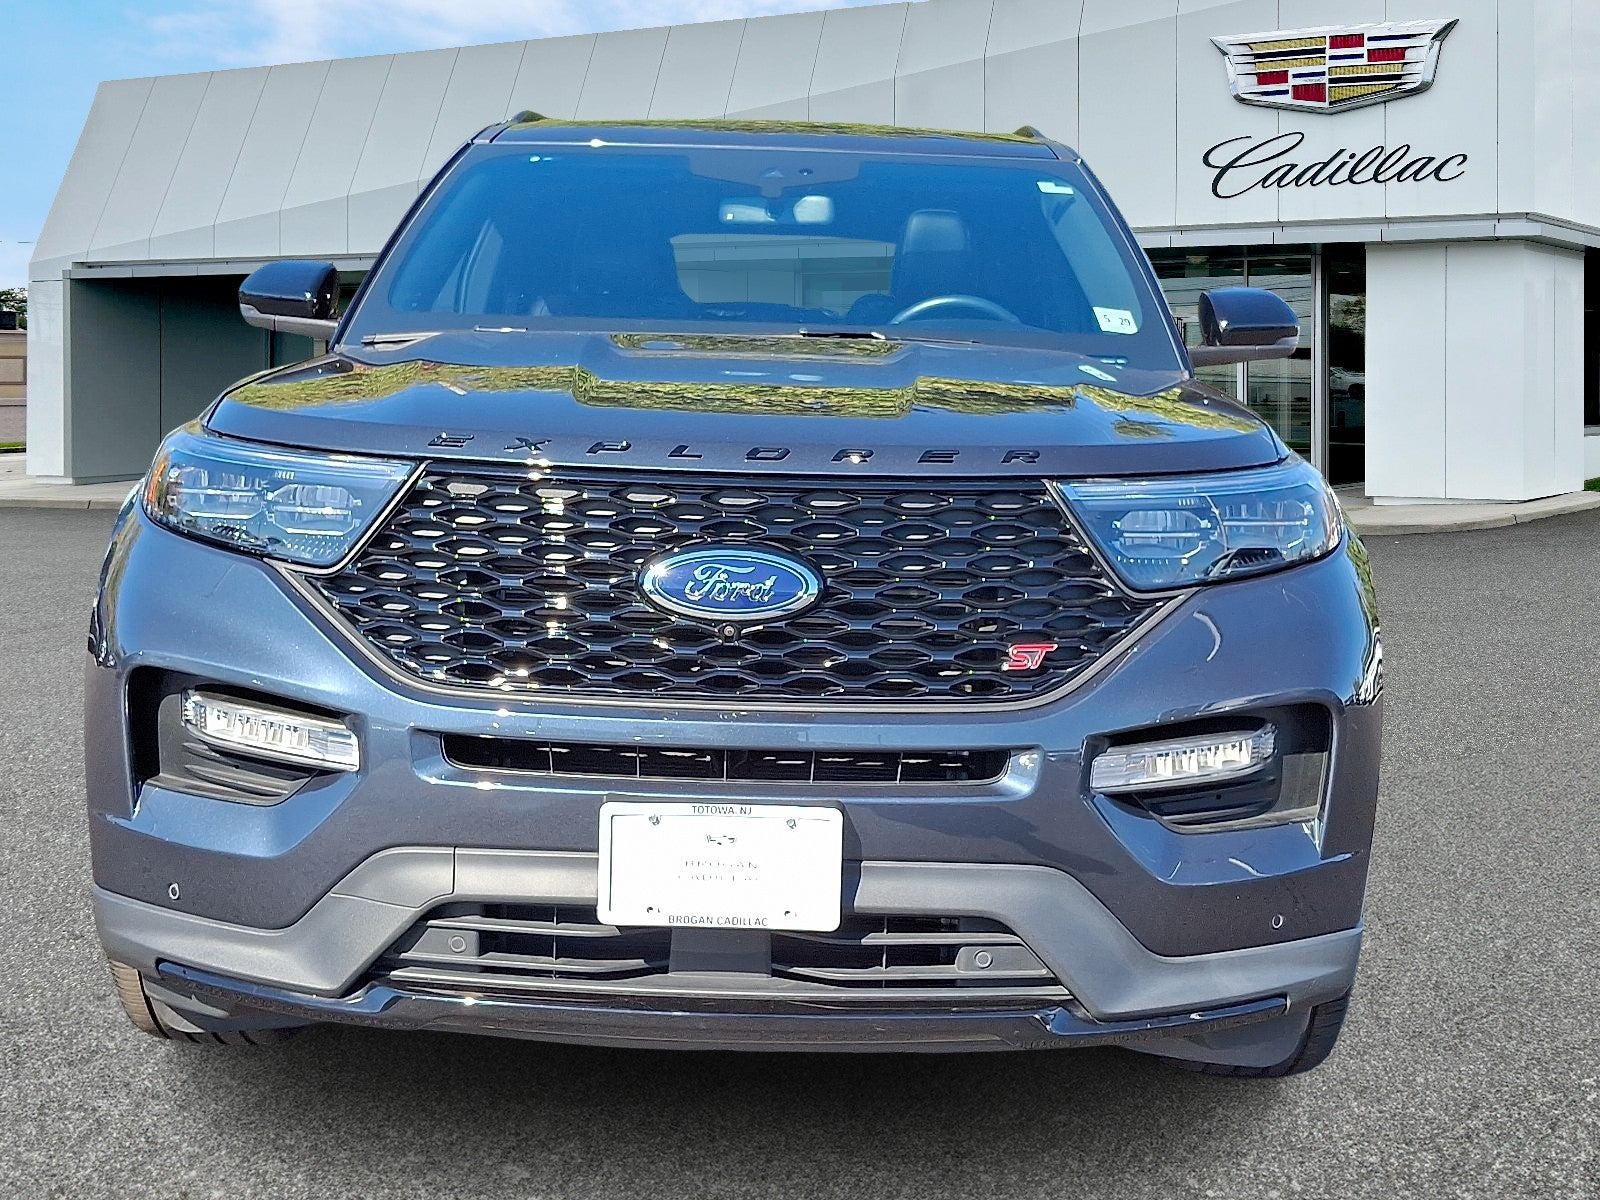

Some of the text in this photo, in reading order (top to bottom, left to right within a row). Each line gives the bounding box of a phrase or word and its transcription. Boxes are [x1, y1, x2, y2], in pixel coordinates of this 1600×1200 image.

[1202, 131, 1467, 199] Cadillac
[427, 431, 1041, 464] EXPLORER
[684, 563, 778, 603] Ford
[1001, 643, 1058, 671] ST
[739, 807, 752, 816] NJ
[668, 915, 769, 927] BROGAN CADILLAC
